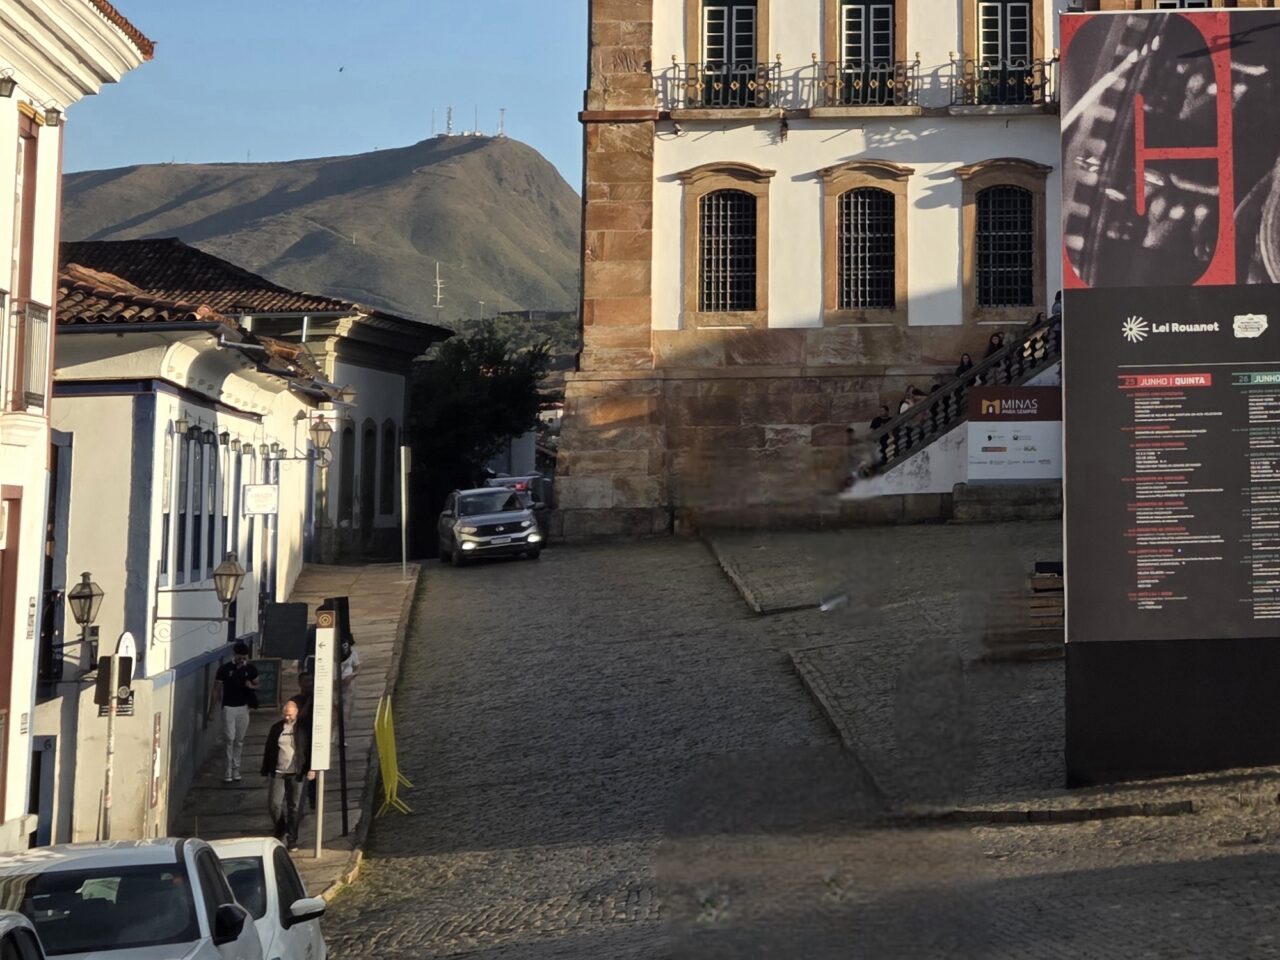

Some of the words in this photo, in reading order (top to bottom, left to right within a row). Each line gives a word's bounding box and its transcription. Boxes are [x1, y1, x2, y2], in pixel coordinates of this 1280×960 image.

[1152, 322, 1170, 333] Lei
[1171, 321, 1220, 333] Rouanet
[1140, 377, 1168, 386] JUNHO
[1174, 376, 1206, 385] QUINTA
[1254, 374, 1280, 383] JUNHO
[1002, 399, 1038, 409] MINAS
